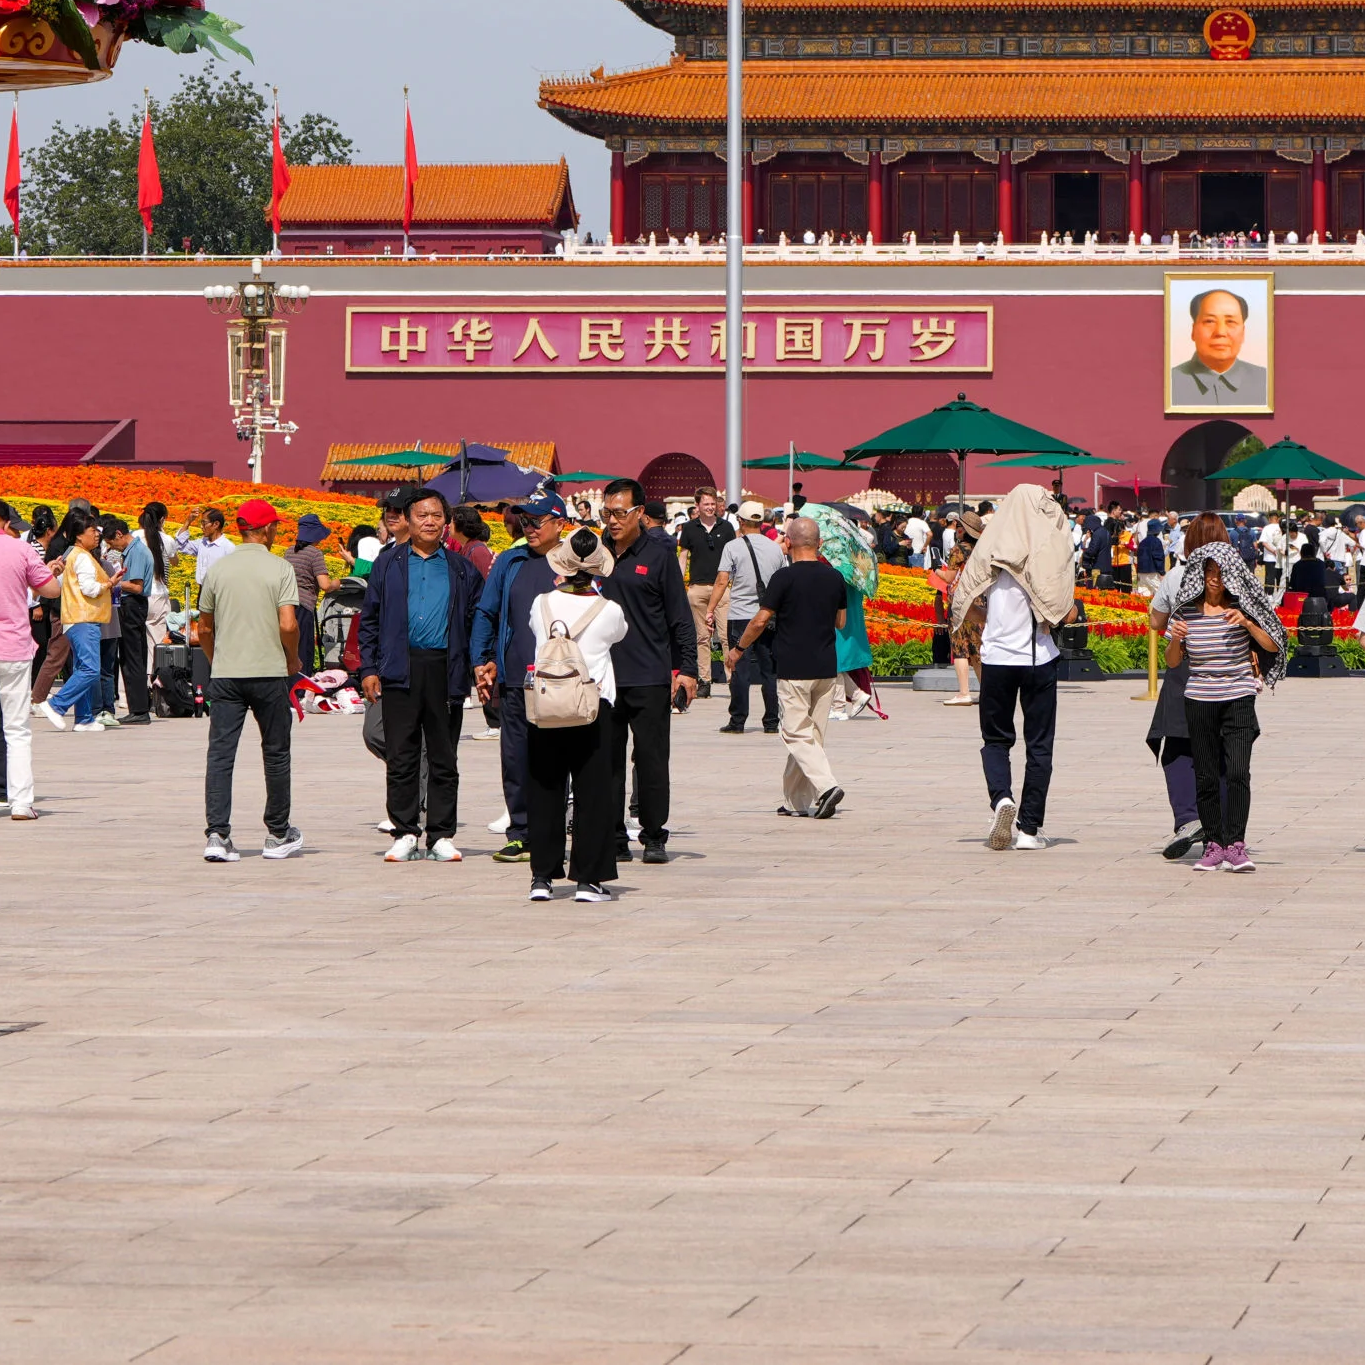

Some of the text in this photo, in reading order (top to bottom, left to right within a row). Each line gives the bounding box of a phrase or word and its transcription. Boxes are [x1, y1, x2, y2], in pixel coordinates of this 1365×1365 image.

[381, 317, 956, 362] 中华人民共和国万岁
